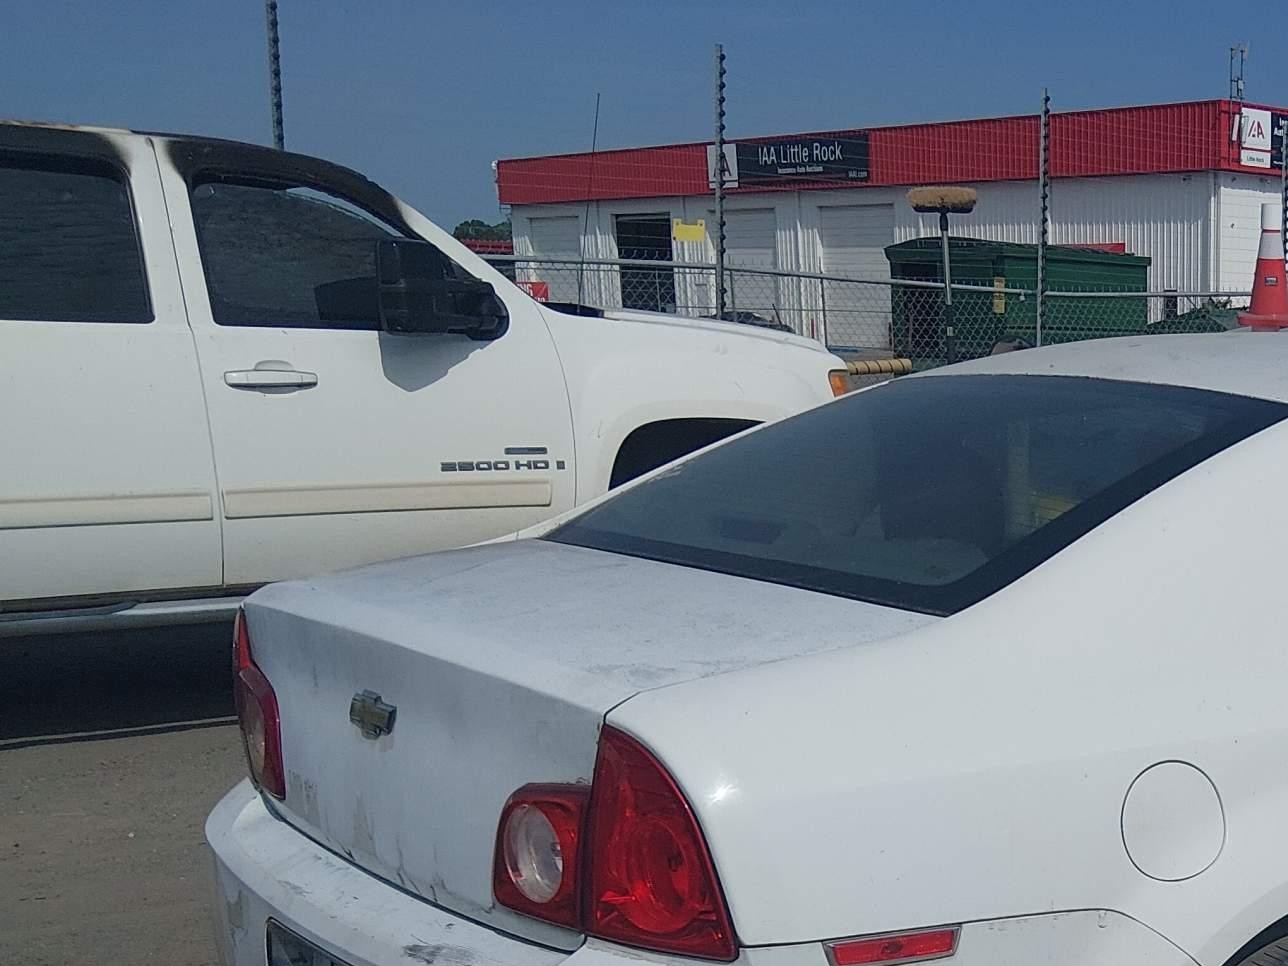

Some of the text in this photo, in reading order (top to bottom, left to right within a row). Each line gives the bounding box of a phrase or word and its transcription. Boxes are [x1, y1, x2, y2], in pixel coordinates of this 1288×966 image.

[758, 141, 843, 165] IAA Little Rock
[515, 460, 549, 470] HD
